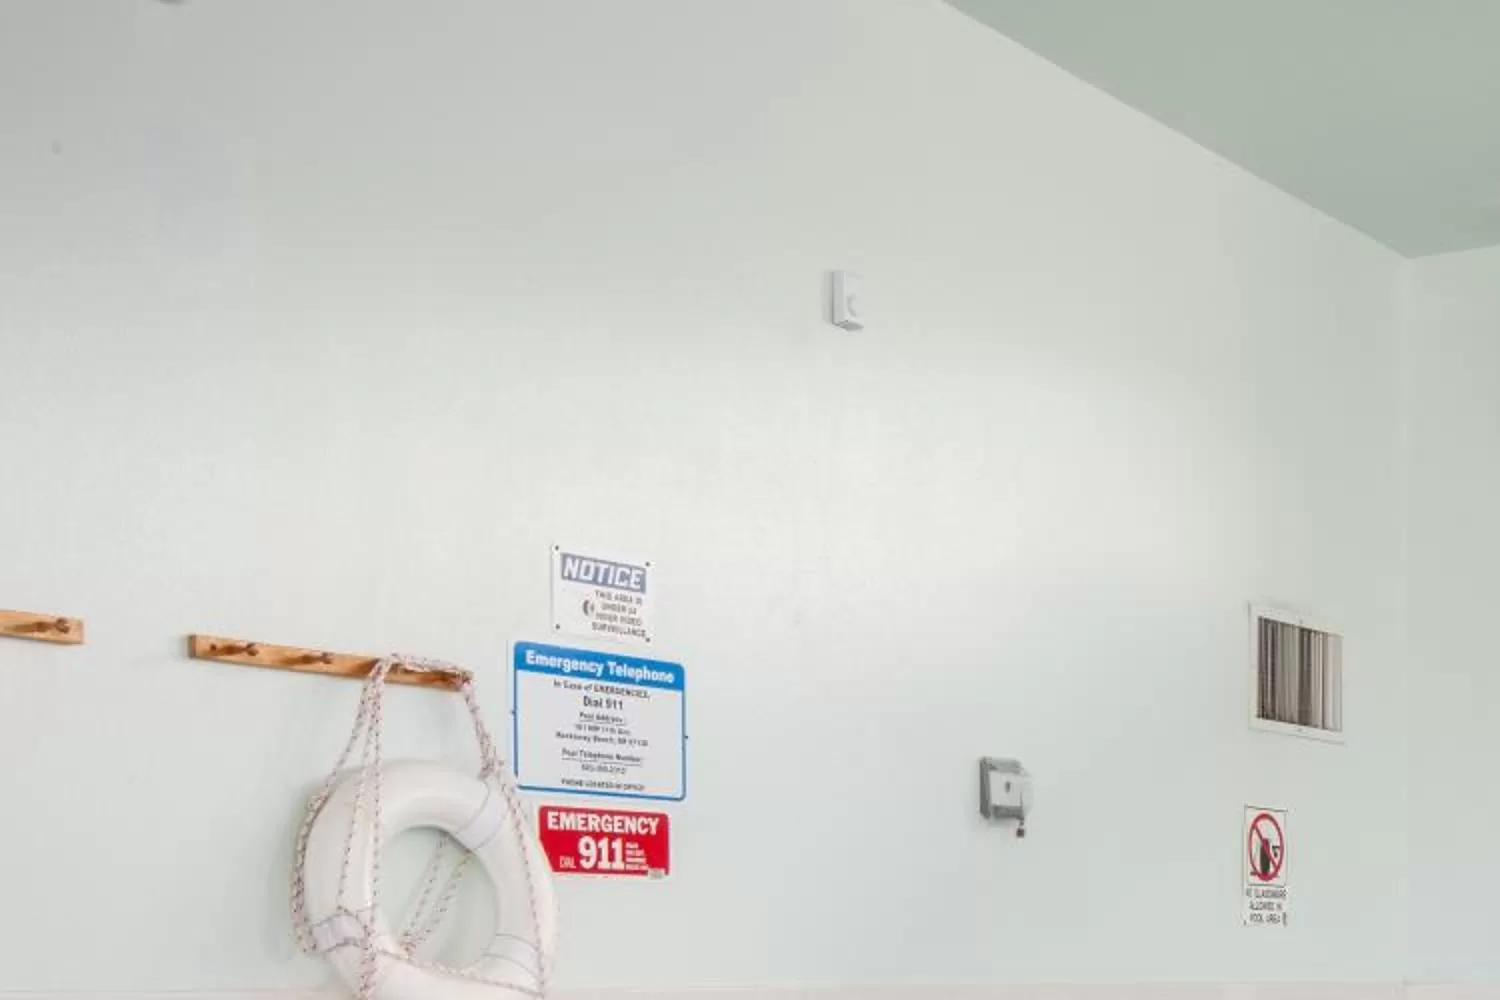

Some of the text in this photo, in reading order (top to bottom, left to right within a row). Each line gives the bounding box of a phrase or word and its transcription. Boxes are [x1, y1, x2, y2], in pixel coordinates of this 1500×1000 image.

[564, 556, 644, 589] NOTICE
[525, 650, 675, 684] Emergency Telephone
[584, 695, 623, 710] Dial 911
[547, 811, 660, 835] EMERGENCY
[578, 835, 624, 870] 911
